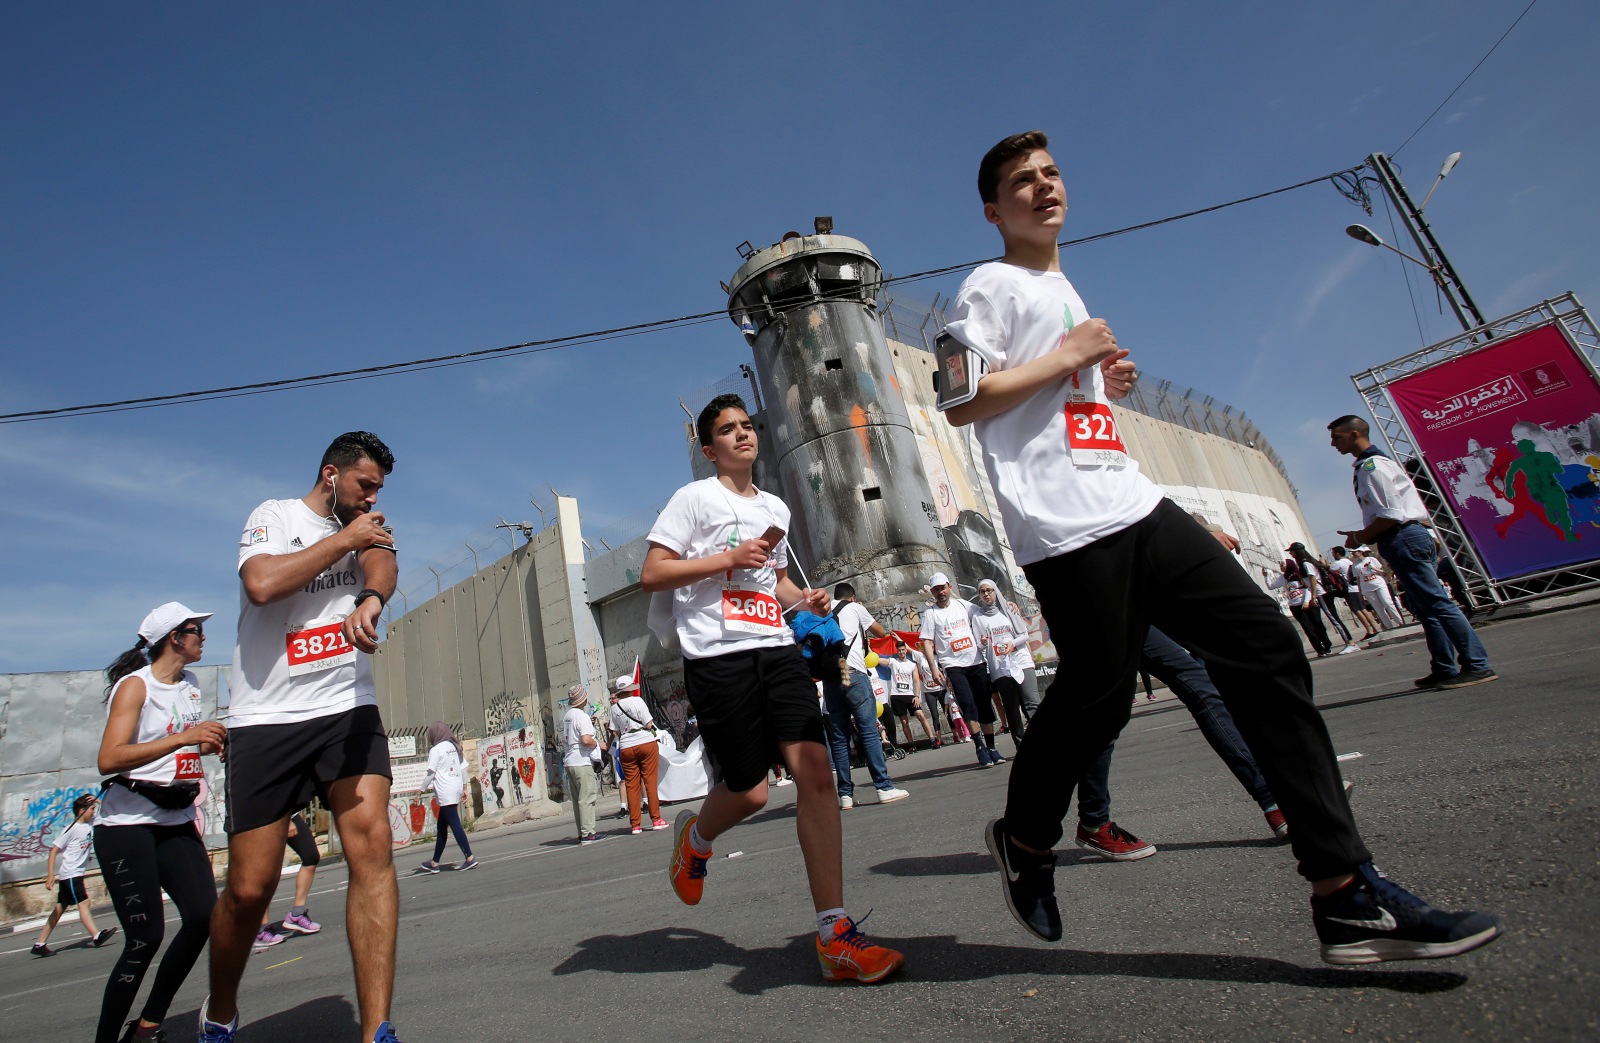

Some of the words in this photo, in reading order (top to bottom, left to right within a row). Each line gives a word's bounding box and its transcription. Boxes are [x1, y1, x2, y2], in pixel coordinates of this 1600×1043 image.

[1463, 379, 1512, 407] اركضوا
[1420, 397, 1463, 421] للحرية
[1426, 414, 1462, 431] FREEDOM
[1463, 409, 1475, 418] OF
[1476, 392, 1519, 413] MOVEMENT
[1072, 413, 1123, 445] 327
[730, 597, 778, 621] 2603
[293, 632, 349, 658] 3821
[953, 638, 971, 650] 6544
[111, 858, 147, 923] NIKE
[117, 938, 148, 984] AIR
